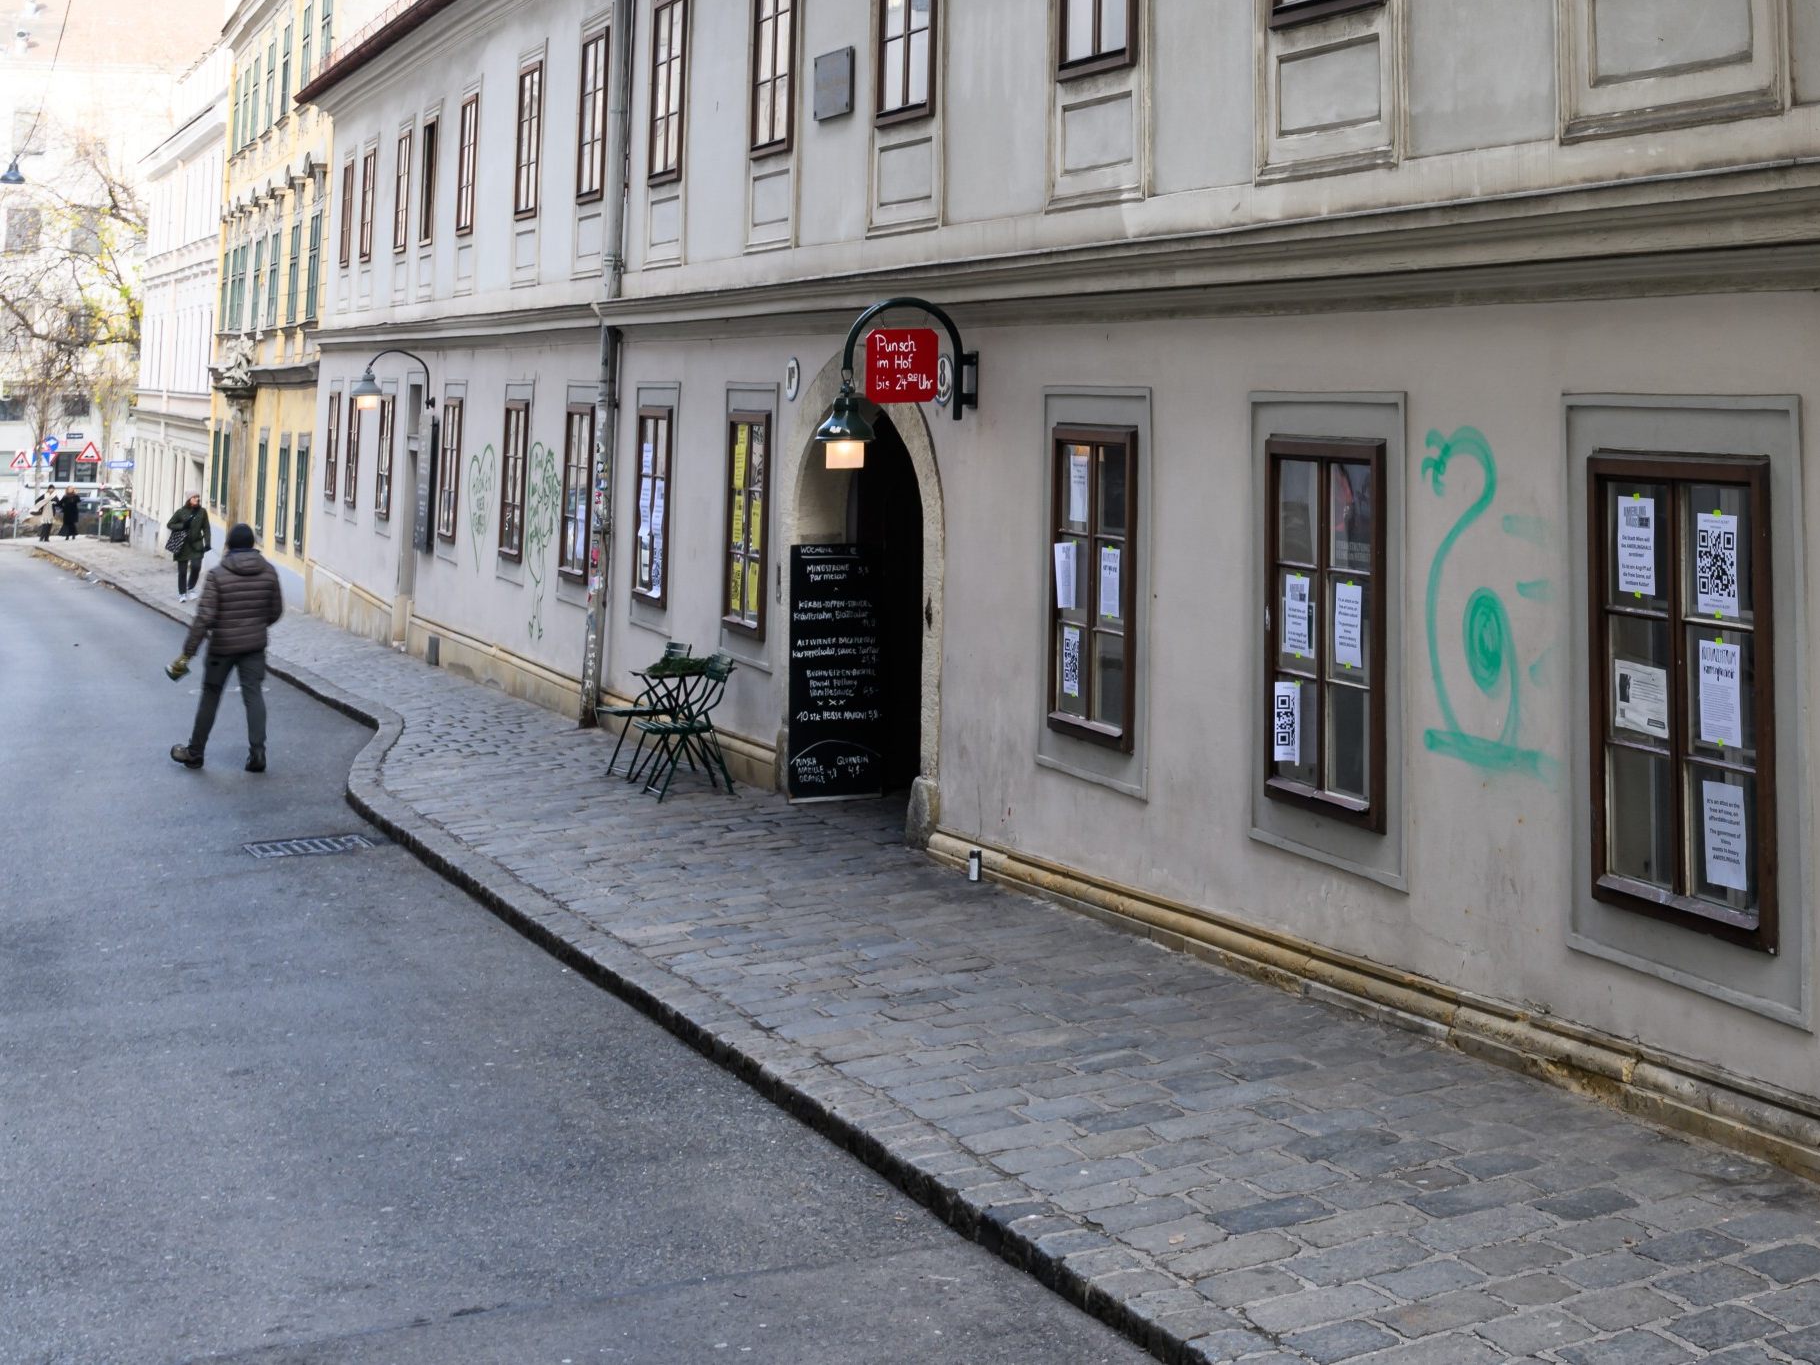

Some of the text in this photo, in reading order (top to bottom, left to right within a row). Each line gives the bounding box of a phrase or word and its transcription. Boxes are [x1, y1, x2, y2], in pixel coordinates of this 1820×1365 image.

[874, 333, 917, 352] Punsch
[876, 353, 914, 370] im Hof
[875, 375, 890, 391] bis
[918, 374, 934, 390] Uhr
[796, 711, 809, 722] 10
